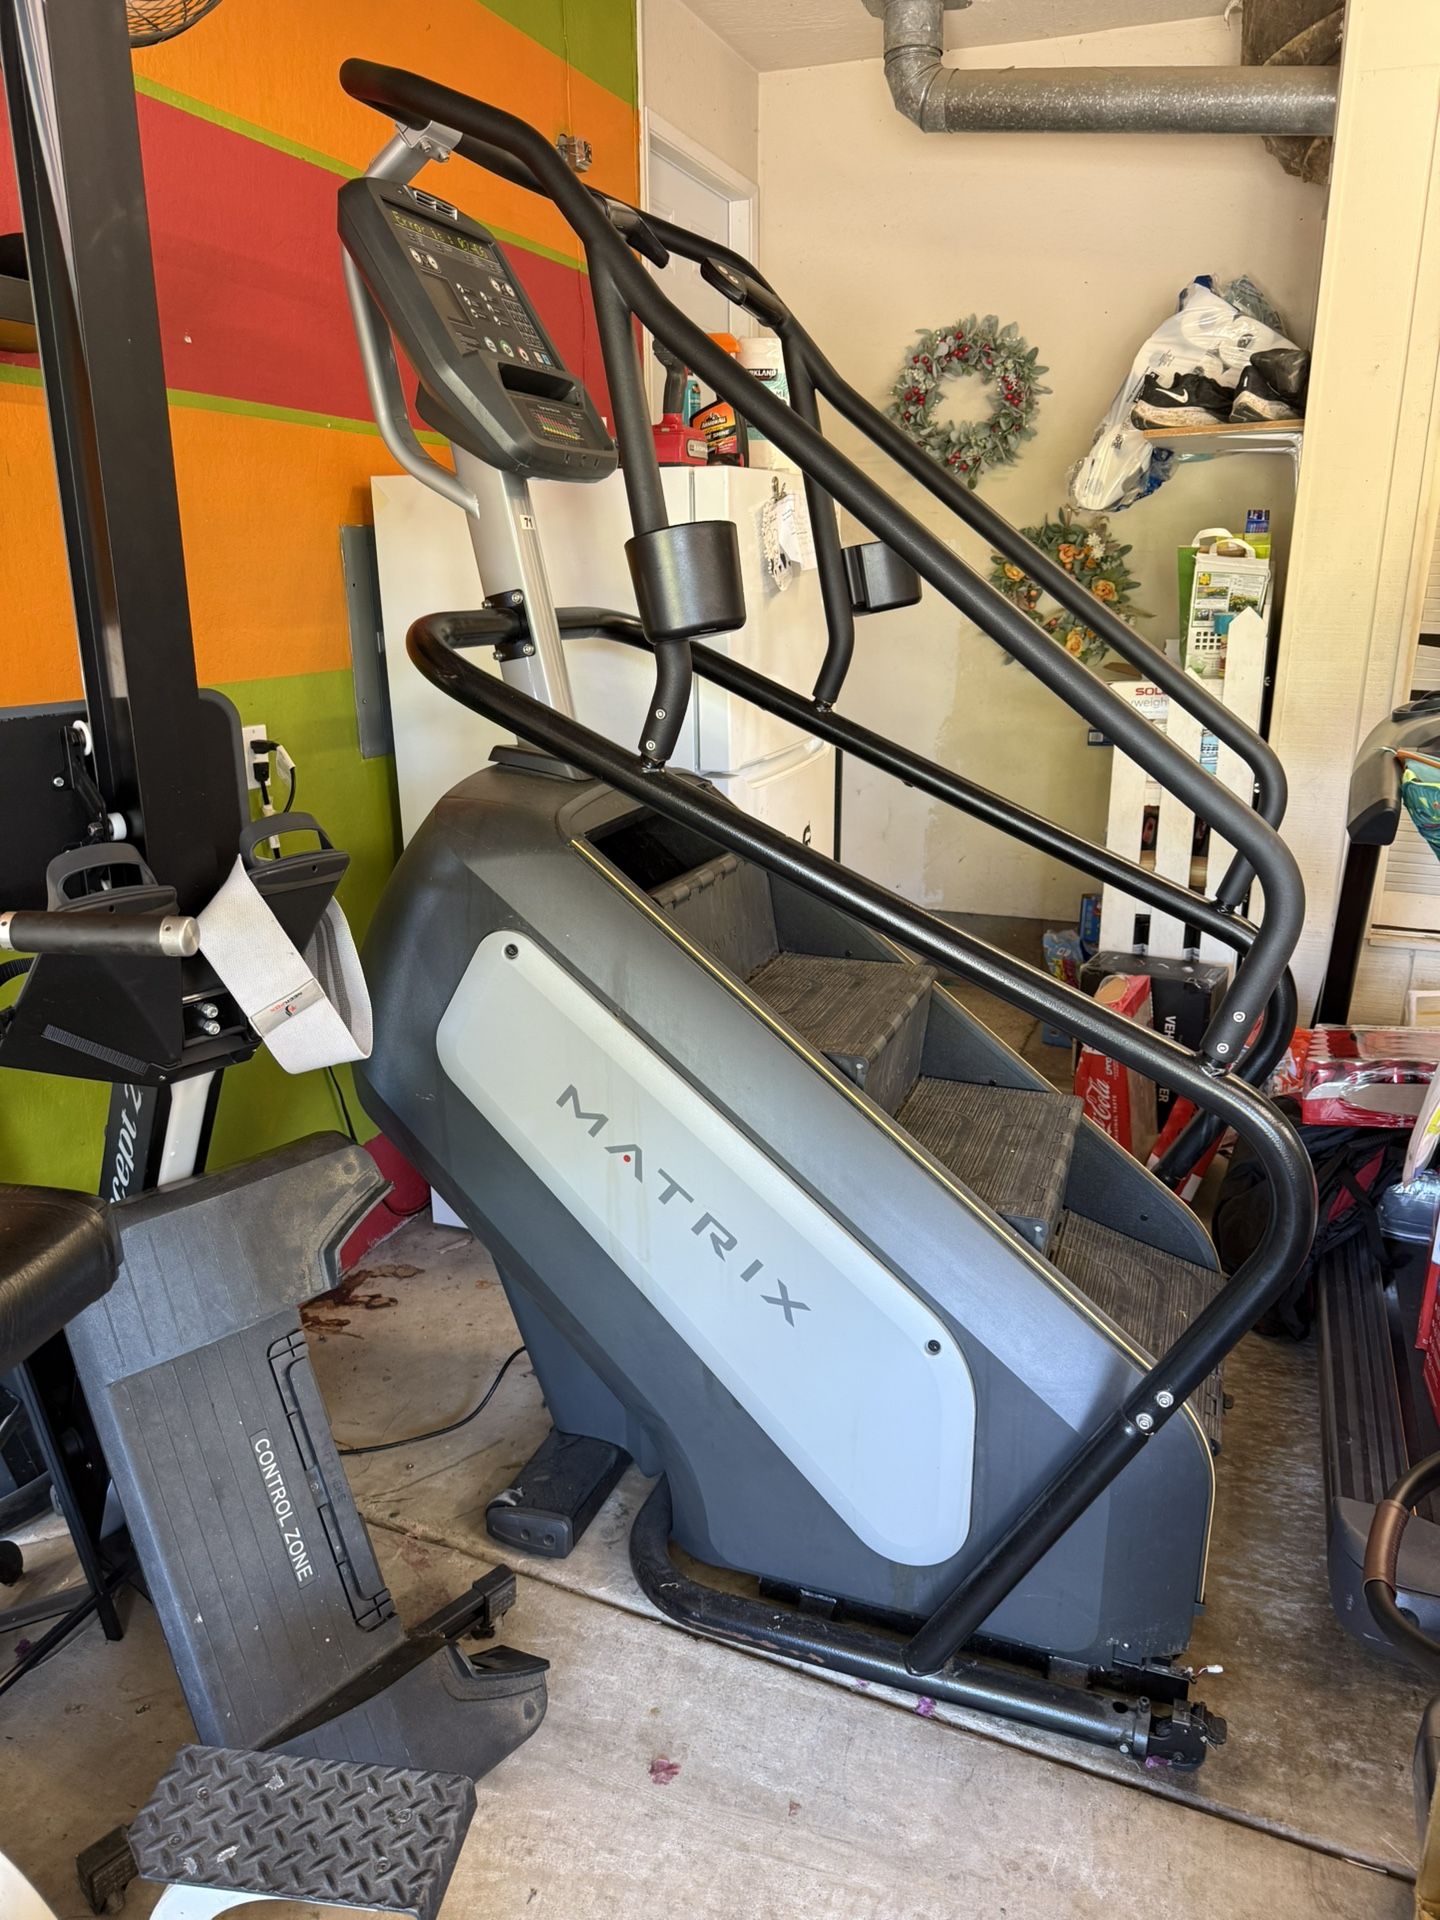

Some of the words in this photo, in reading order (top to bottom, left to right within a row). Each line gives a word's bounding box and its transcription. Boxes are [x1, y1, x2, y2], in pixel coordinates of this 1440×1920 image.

[523, 516, 534, 529] 71
[556, 1083, 812, 1328] MATRIX
[254, 1437, 294, 1528] CONTROL
[284, 1526, 314, 1582] ZONE
